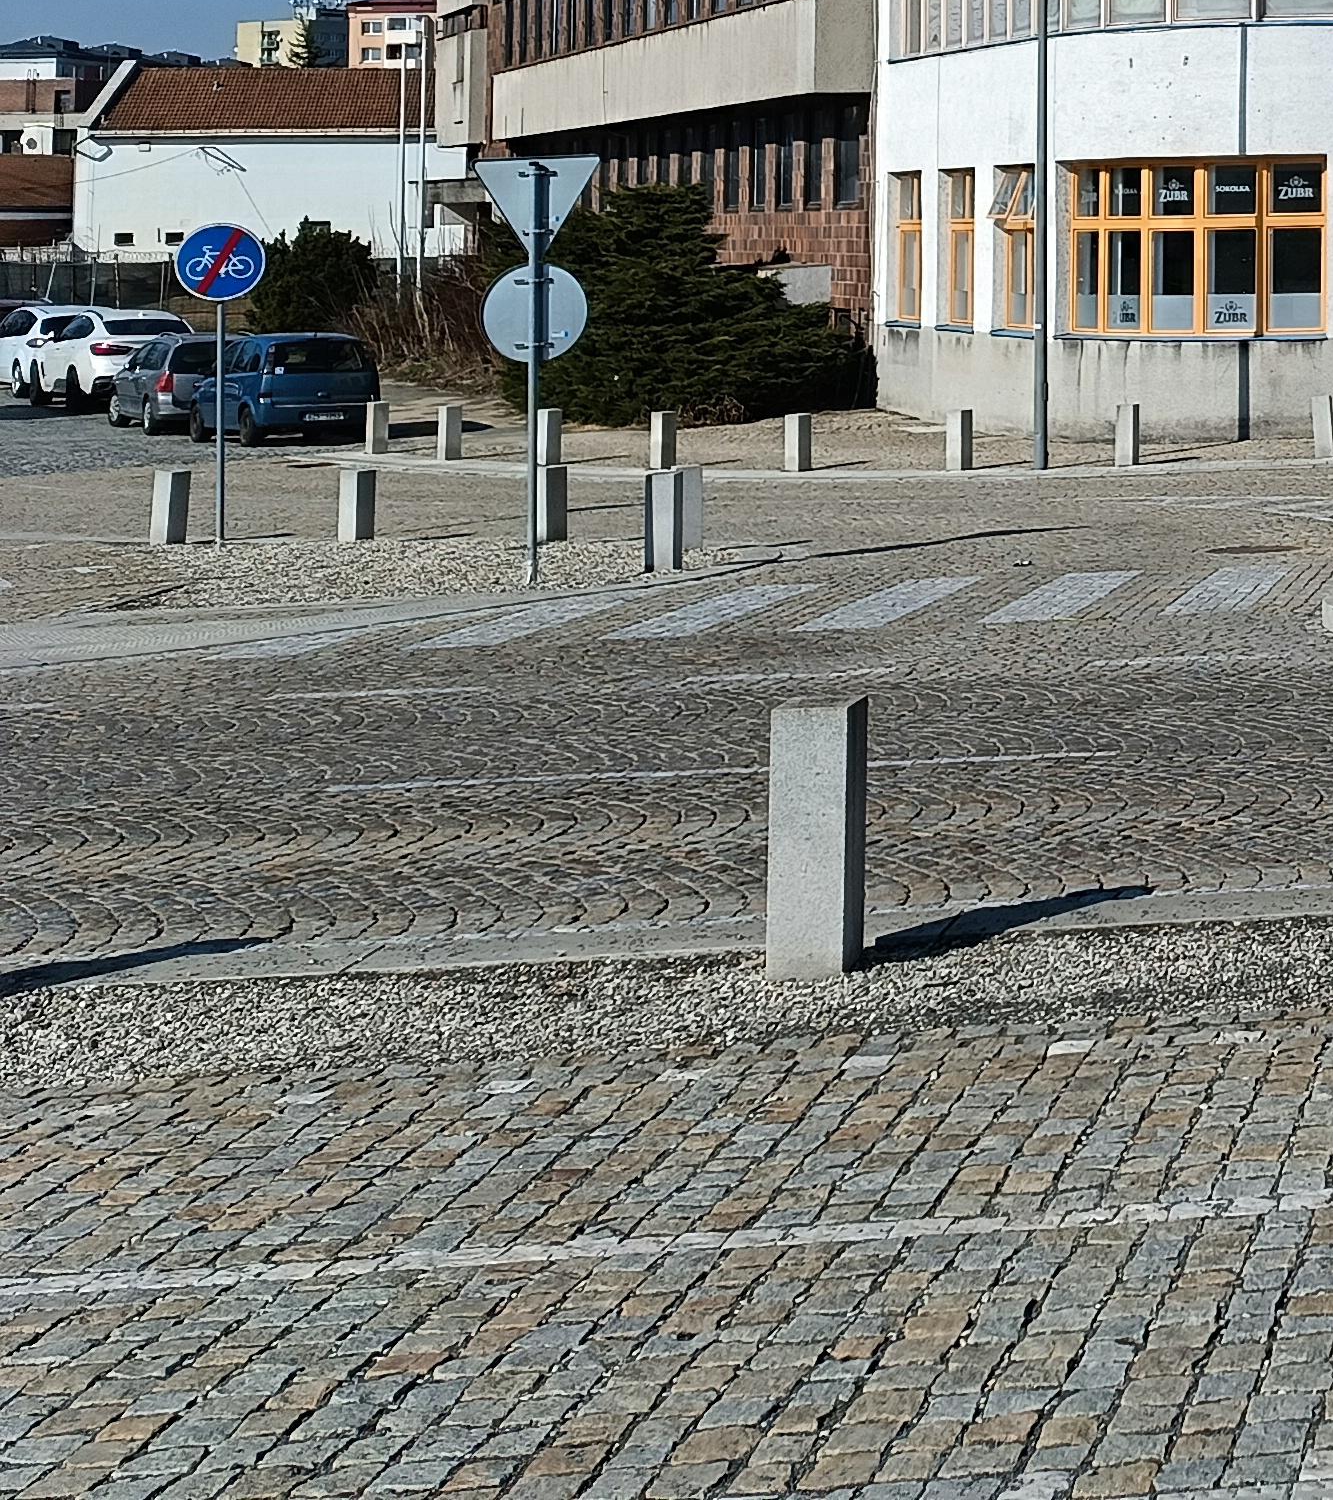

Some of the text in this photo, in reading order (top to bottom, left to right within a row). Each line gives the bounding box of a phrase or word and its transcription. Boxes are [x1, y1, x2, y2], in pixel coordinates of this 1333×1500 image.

[1159, 189, 1188, 203] ZUBR
[1278, 186, 1314, 201] ZUBR
[1214, 310, 1248, 324] ZUBR
